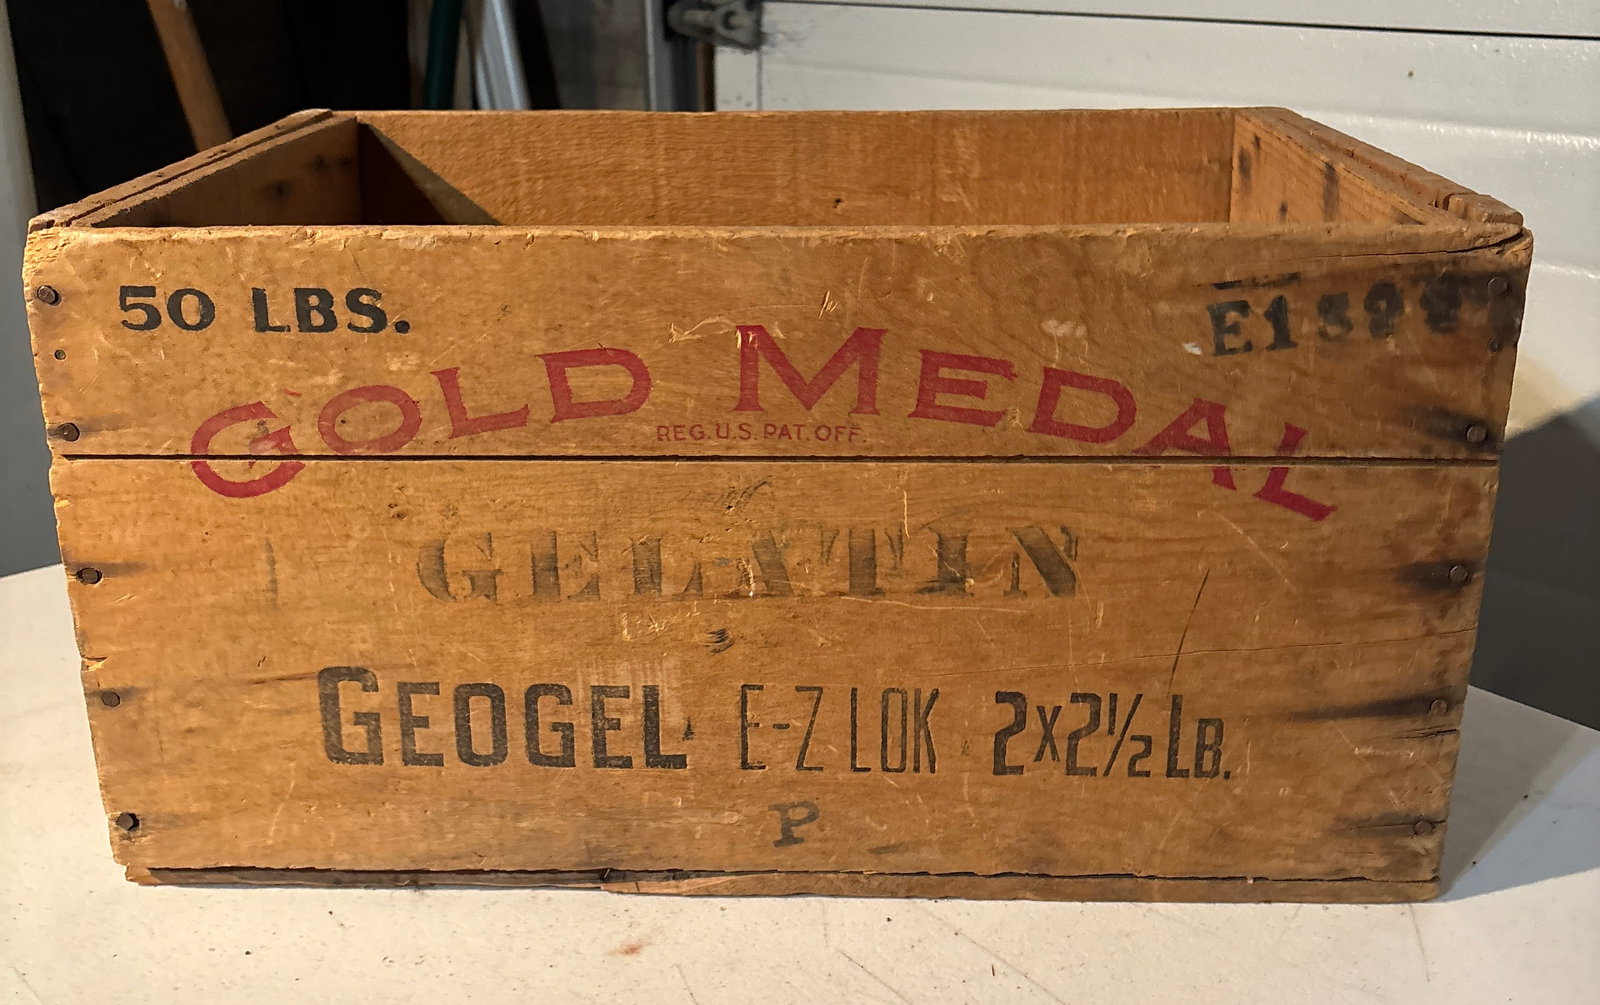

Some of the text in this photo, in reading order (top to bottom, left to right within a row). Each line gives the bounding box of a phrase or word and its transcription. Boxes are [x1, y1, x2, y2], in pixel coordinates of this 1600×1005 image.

[119, 285, 411, 333] 50 LBS.
[190, 325, 1338, 522] GOLD MEDAL
[415, 525, 1081, 601] GELATIN
[318, 666, 687, 769] GEOGEL
[740, 684, 824, 772] E-Z
[850, 687, 940, 775] LOK
[1165, 694, 1232, 780] LB.
[768, 801, 821, 848] P
